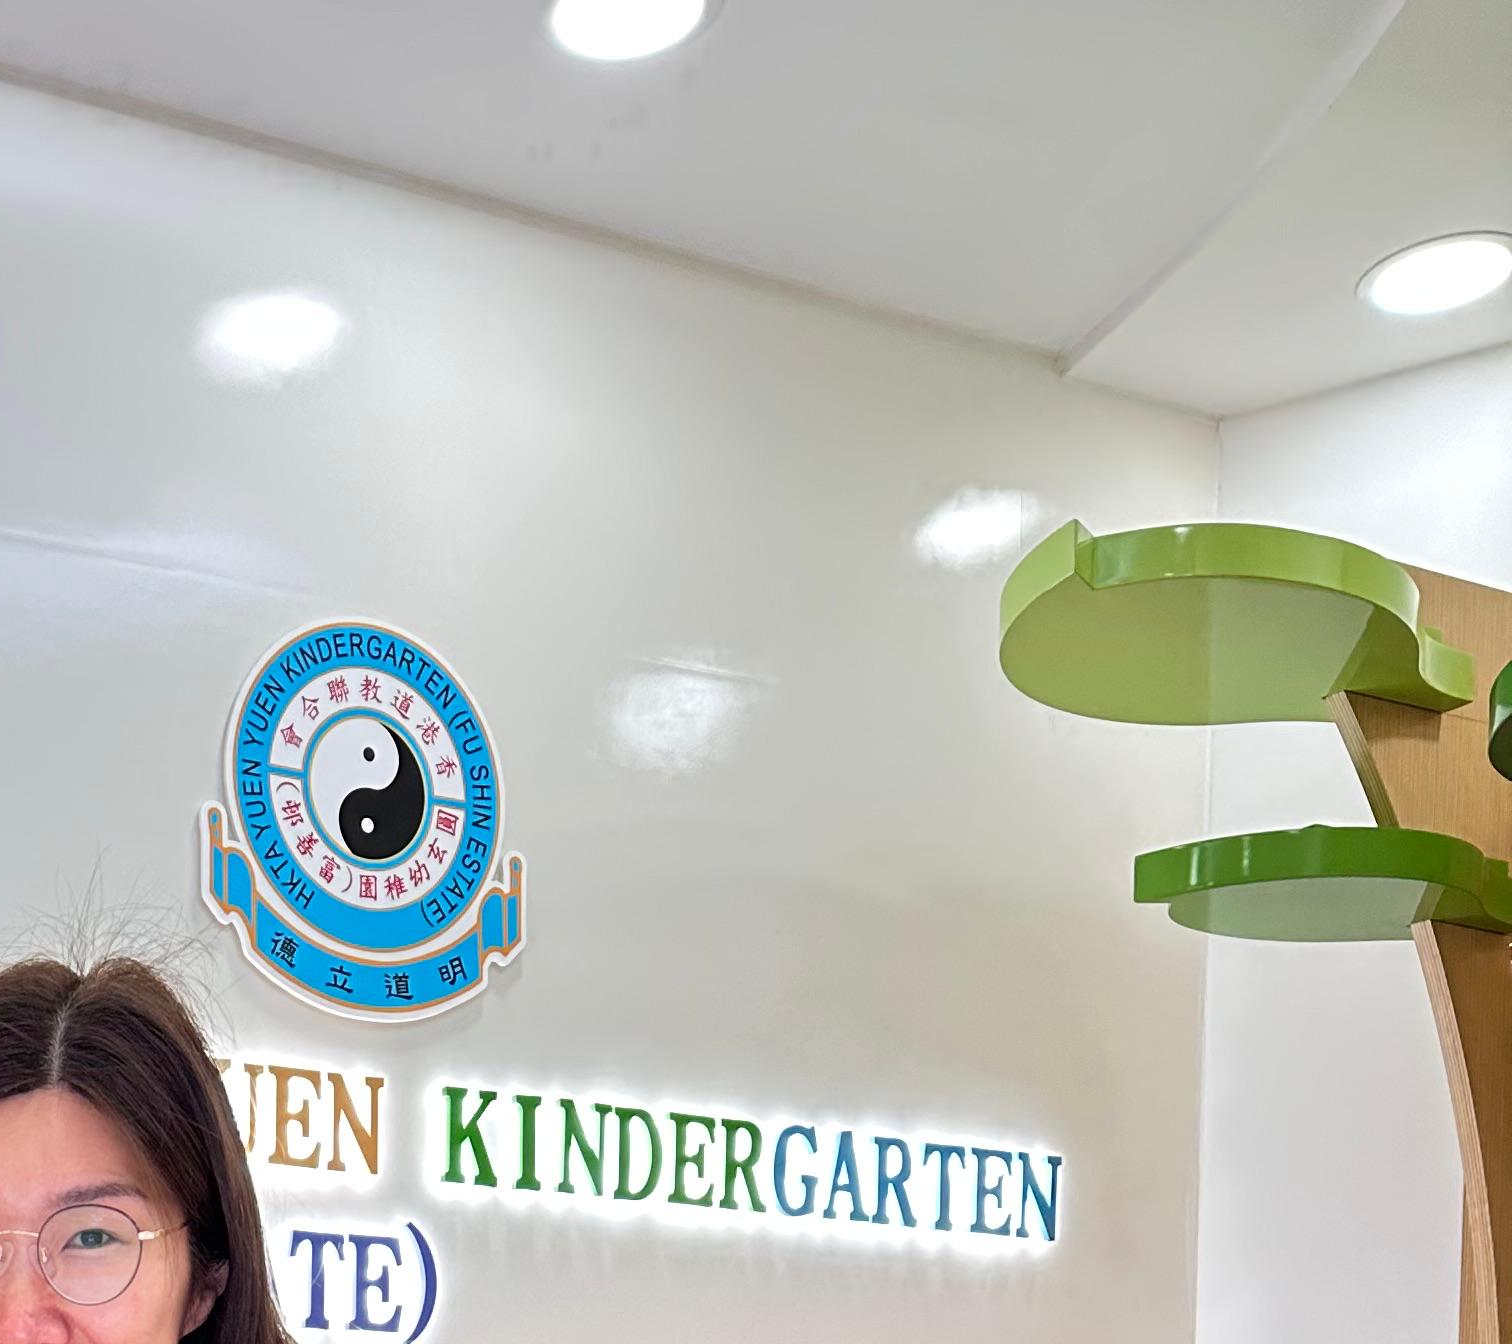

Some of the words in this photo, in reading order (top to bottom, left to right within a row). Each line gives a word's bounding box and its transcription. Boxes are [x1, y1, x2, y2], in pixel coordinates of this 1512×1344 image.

[279, 631, 458, 708] KINDERGARTEN
[242, 674, 282, 745] YUEN
[470, 763, 493, 830] SHIN
[420, 837, 488, 928] ESTATE)
[440, 1086, 1064, 1242] KINDERGARTEN
